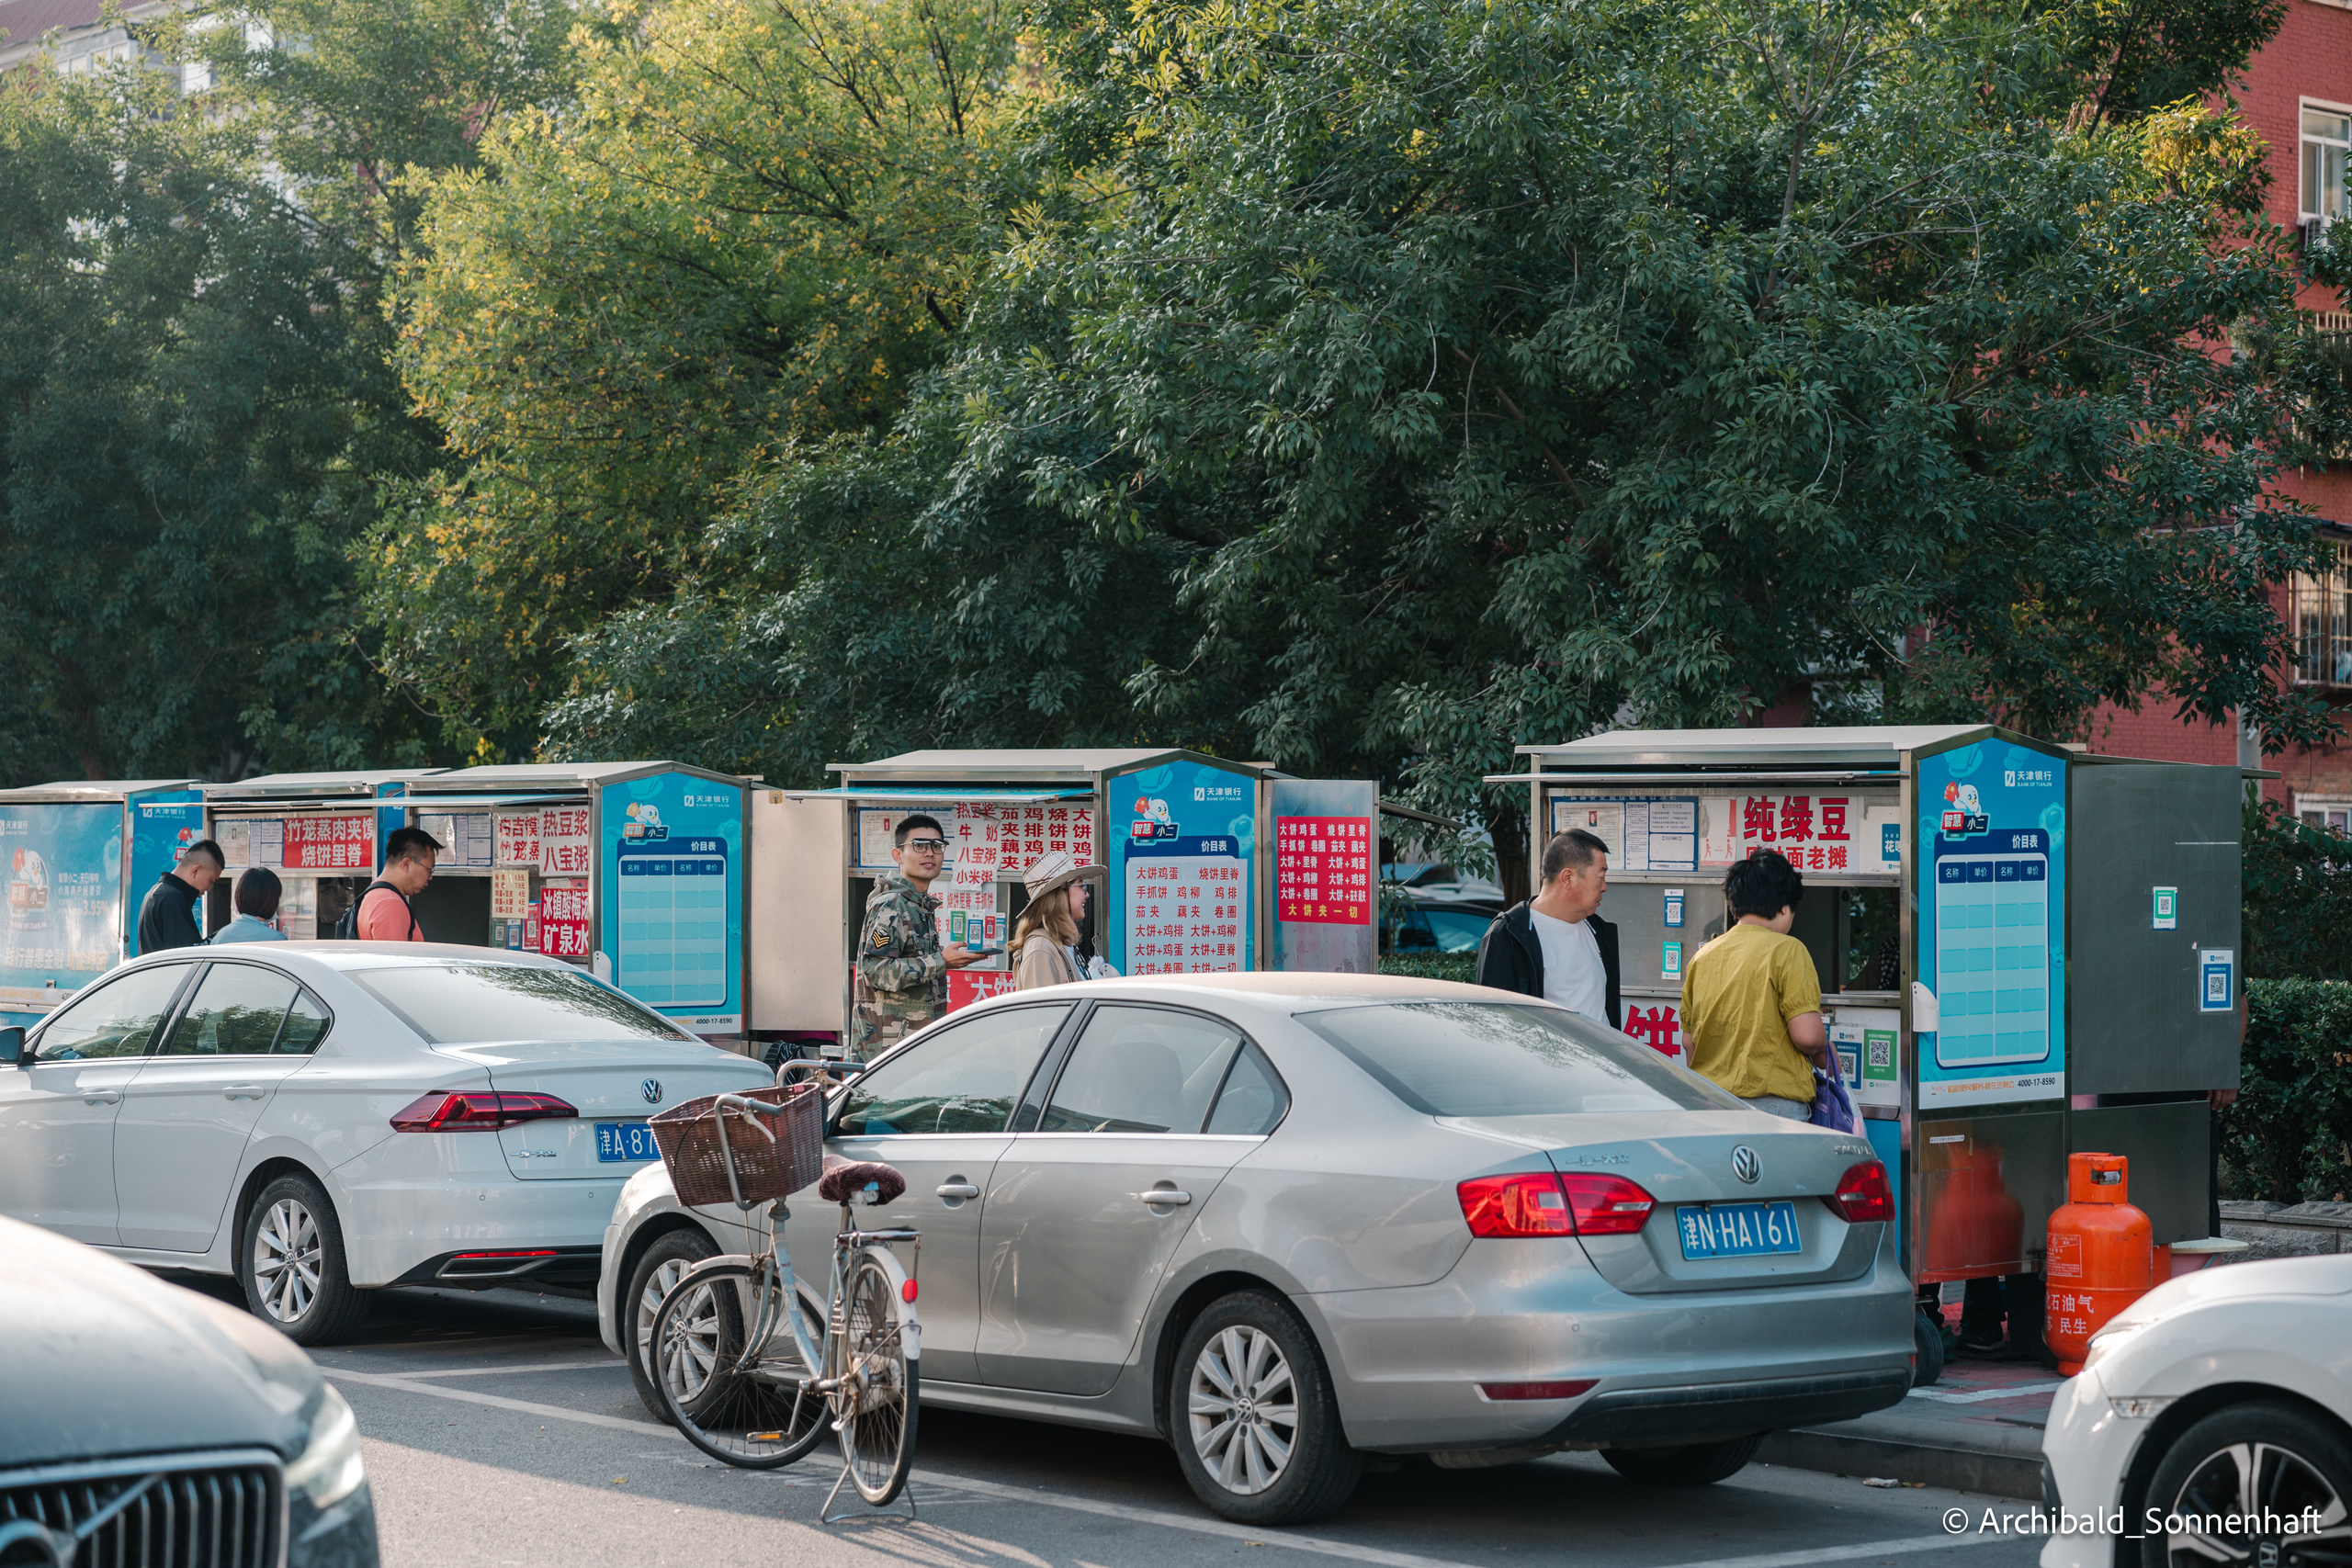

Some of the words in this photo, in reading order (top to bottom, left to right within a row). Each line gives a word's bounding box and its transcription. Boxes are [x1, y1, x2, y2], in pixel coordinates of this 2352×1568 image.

[2018, 771, 2052, 781] 天津银行
[1206, 787, 1242, 796] 天津银行
[696, 795, 729, 804] 天津银行
[543, 809, 588, 838] 热豆浆
[1743, 795, 1850, 843] 纯绿豆
[287, 818, 373, 842] 竹笼蒸肉夹馍
[1279, 823, 1317, 836] 大饼鸡蛋
[1327, 824, 1366, 837] 烧饼里脊
[691, 841, 717, 852] 价目表
[1201, 840, 1227, 852] 价目表
[1280, 840, 1306, 852] 手抓饼
[1311, 840, 1326, 852] 卷圈
[1330, 840, 1346, 852] 茄夹
[2012, 834, 2039, 849] 价目表
[300, 843, 362, 867] 烧饼里脊
[499, 840, 539, 862] 竹笼蒸
[543, 844, 588, 873] 八宝粥
[958, 847, 998, 865] 八宝粥
[1746, 845, 1848, 870] 面老摊
[956, 870, 993, 885] 小米粥
[1136, 866, 1179, 880] 大饼鸡蛋
[1199, 867, 1239, 881] 烧饼里脊
[1945, 867, 1960, 878] 名称
[1974, 867, 1987, 877] 单价
[2000, 866, 2014, 877] 名称
[2027, 865, 2040, 876] 单价
[1136, 886, 1168, 899] 手抓饼
[1177, 886, 1201, 899] 鸡柳
[1215, 886, 1238, 899] 鸡排
[543, 889, 588, 921] 冰镇酸梅汤
[947, 892, 971, 909] 烧饼里脊
[975, 892, 994, 909] 手抓饼
[1136, 905, 1159, 919] 茄夹
[1177, 905, 1201, 919] 藕夹
[1288, 903, 1358, 919] 大饼夹一切
[543, 923, 588, 954] 矿泉水
[1623, 1004, 1680, 1059] 饼
[2018, 1077, 2055, 1088] 4000-17-8590
[2060, 1317, 2087, 1334] 民生
